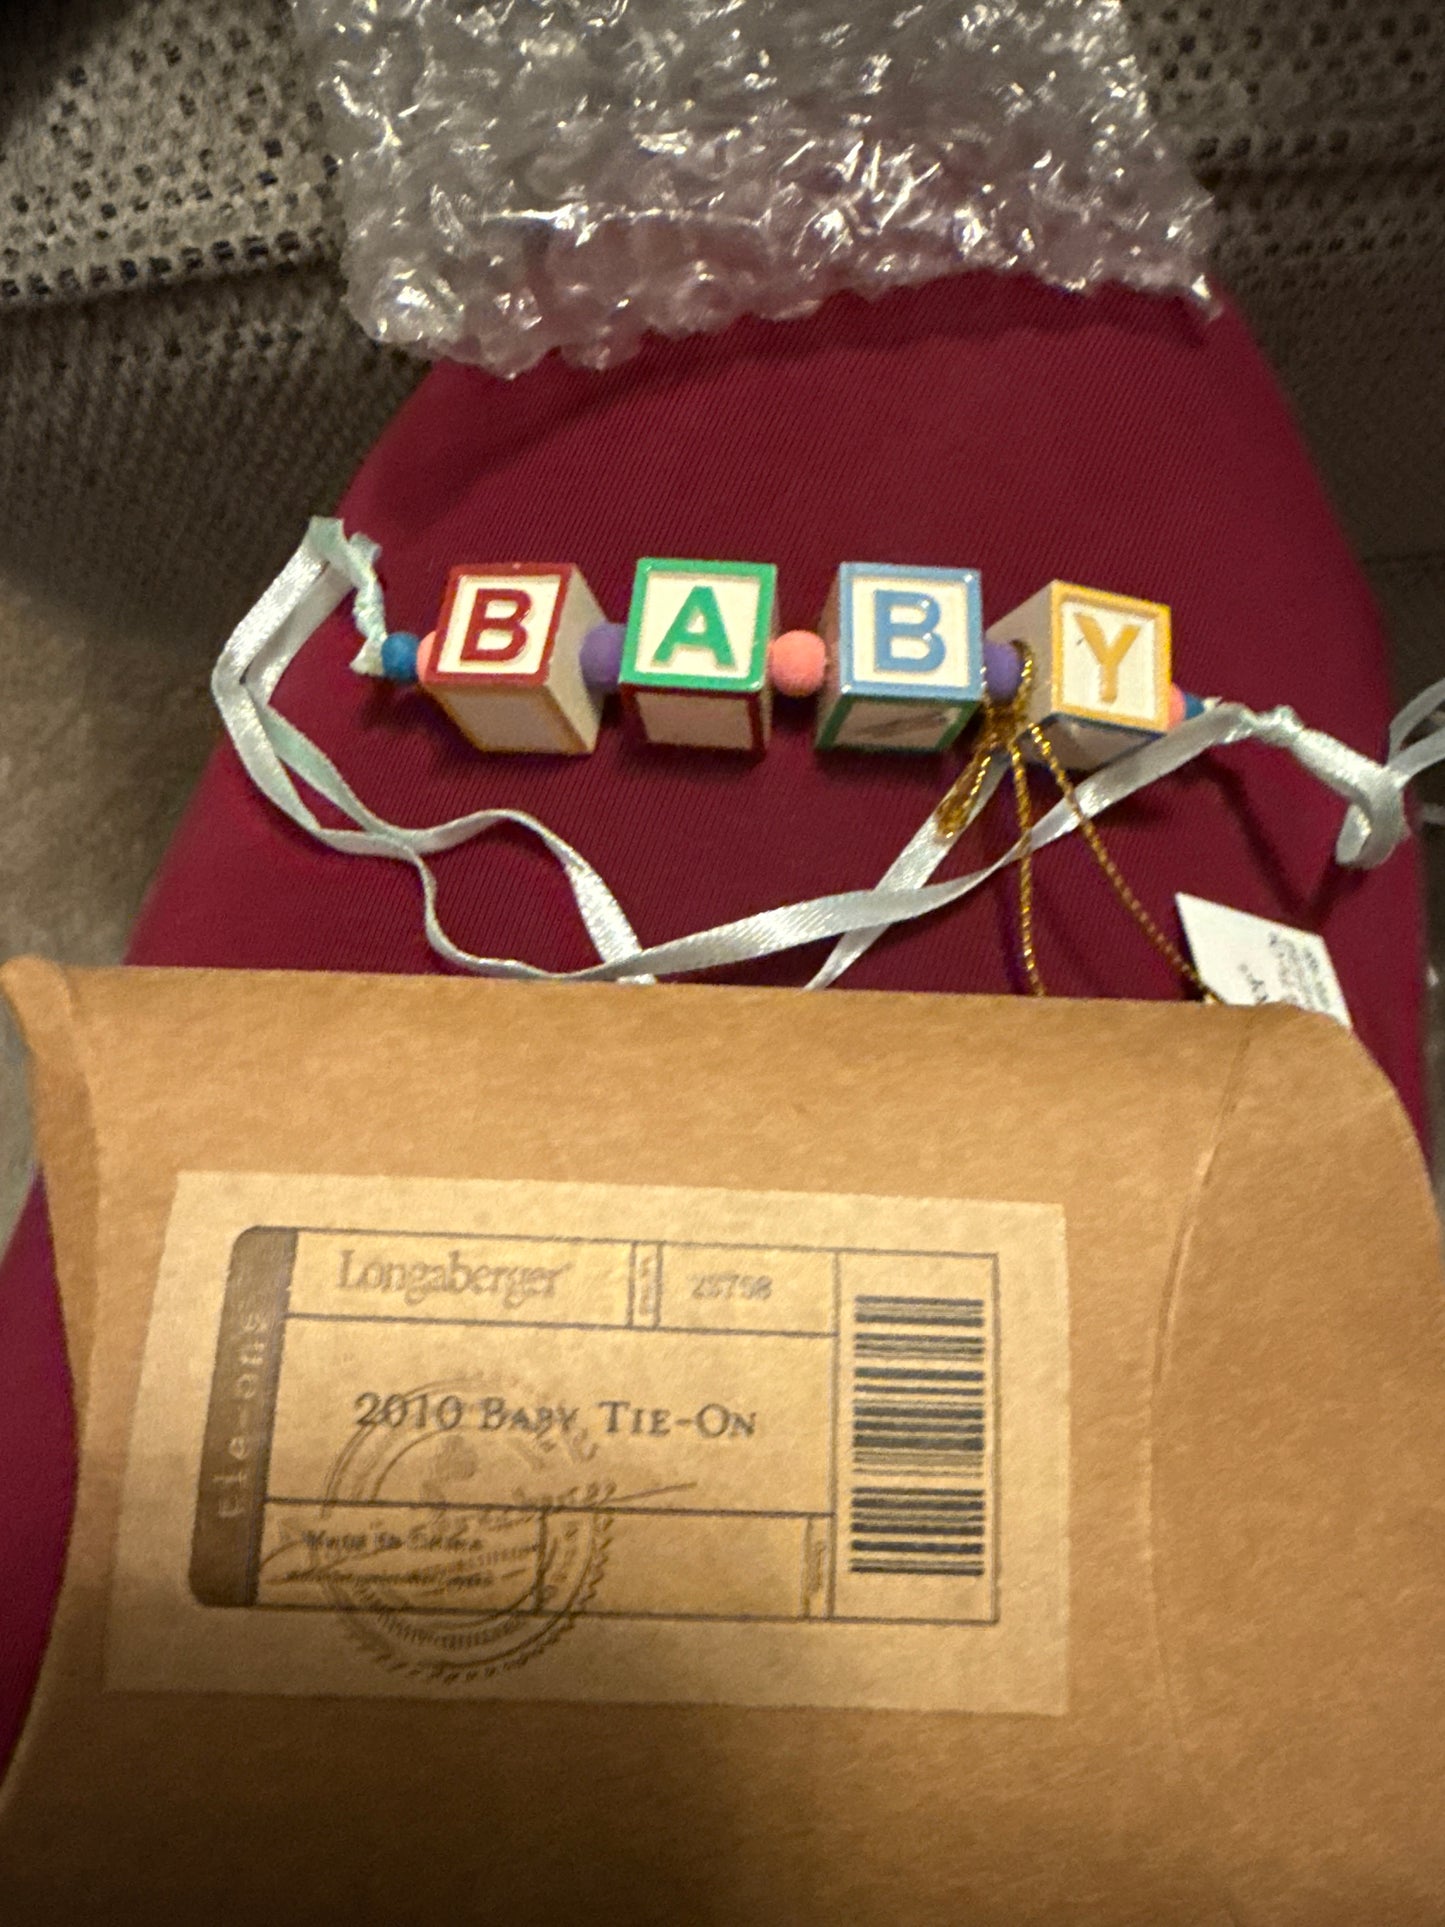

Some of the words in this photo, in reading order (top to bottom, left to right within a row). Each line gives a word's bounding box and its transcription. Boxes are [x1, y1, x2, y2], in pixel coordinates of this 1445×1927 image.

[459, 588, 533, 663] B
[650, 585, 739, 667] A
[873, 589, 948, 673] B
[1073, 611, 1146, 703] Y
[337, 1248, 574, 1309] Longaberger
[352, 1390, 466, 1431] 2010
